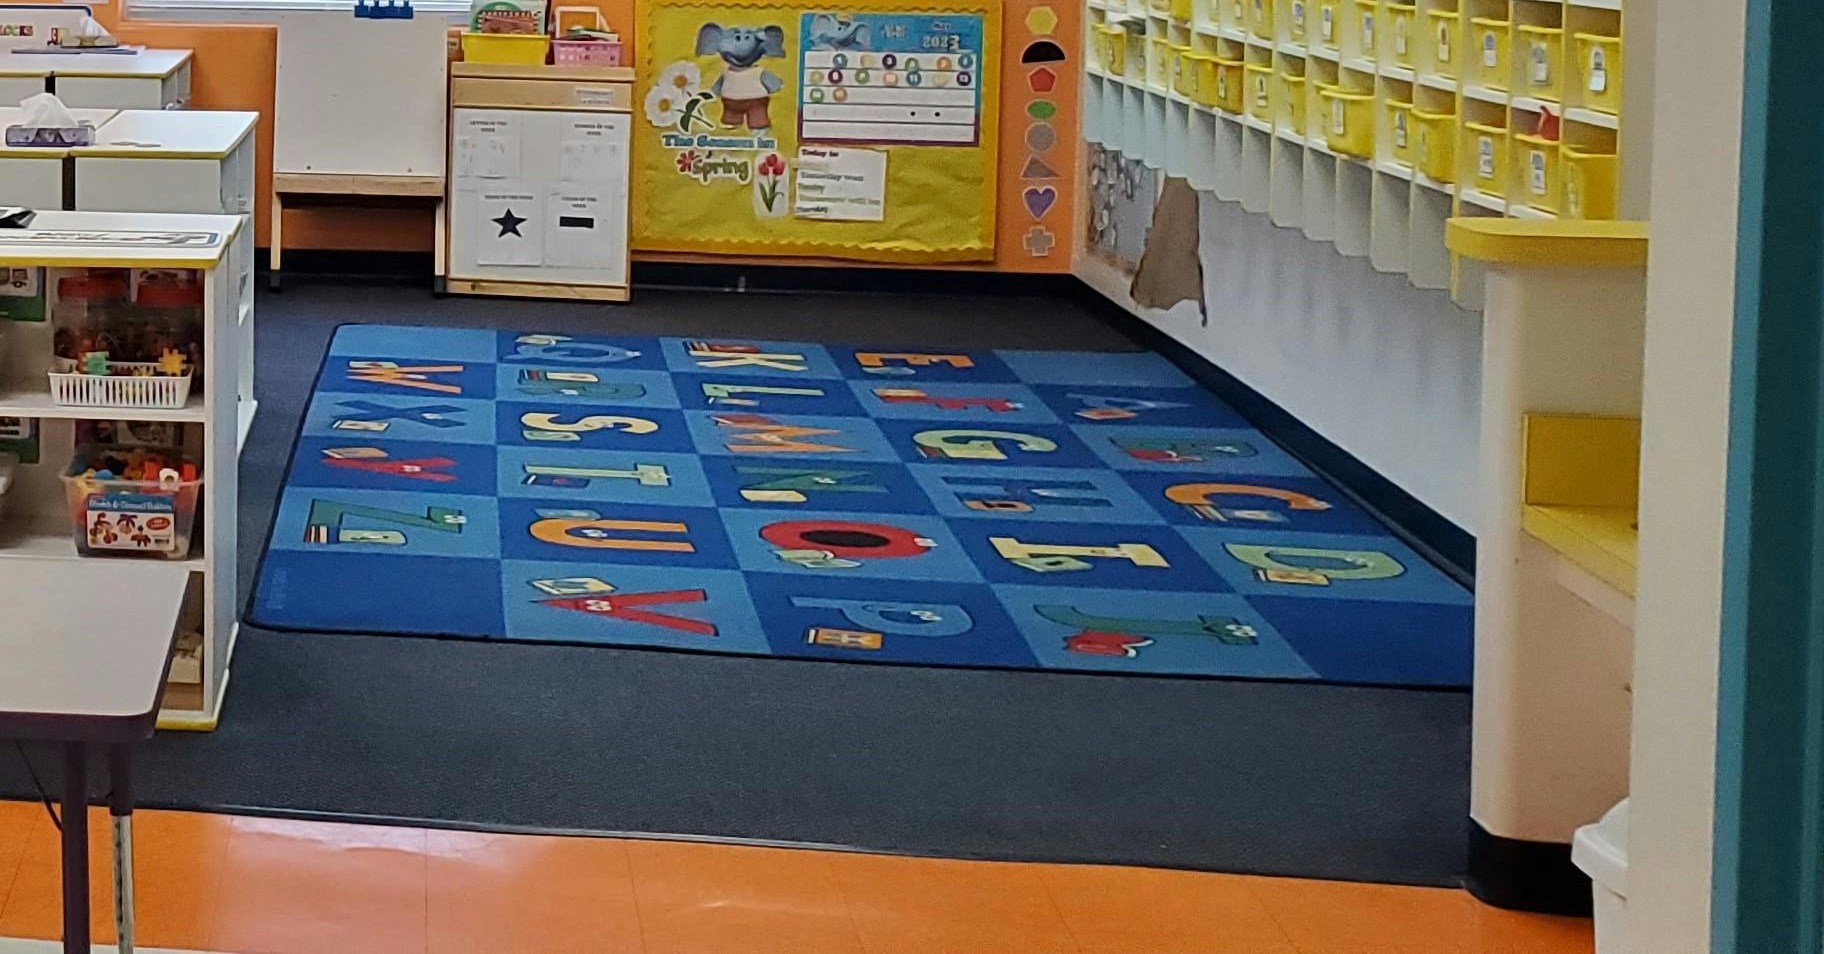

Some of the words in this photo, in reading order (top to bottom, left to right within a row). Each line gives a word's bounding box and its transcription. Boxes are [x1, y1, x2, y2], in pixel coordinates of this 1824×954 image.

[923, 35, 960, 51] 2023
[692, 158, 749, 183] Spring
[688, 349, 809, 371] K
[854, 352, 975, 368] E
[346, 364, 465, 394] W
[520, 412, 659, 436] S
[721, 420, 866, 454] M
[912, 428, 1059, 455] G
[320, 455, 458, 483] Y
[524, 462, 672, 487] T
[1164, 483, 1333, 511] C
[529, 517, 695, 553] U
[1222, 542, 1408, 580] D
[529, 588, 720, 638] V
[788, 596, 974, 638] P
